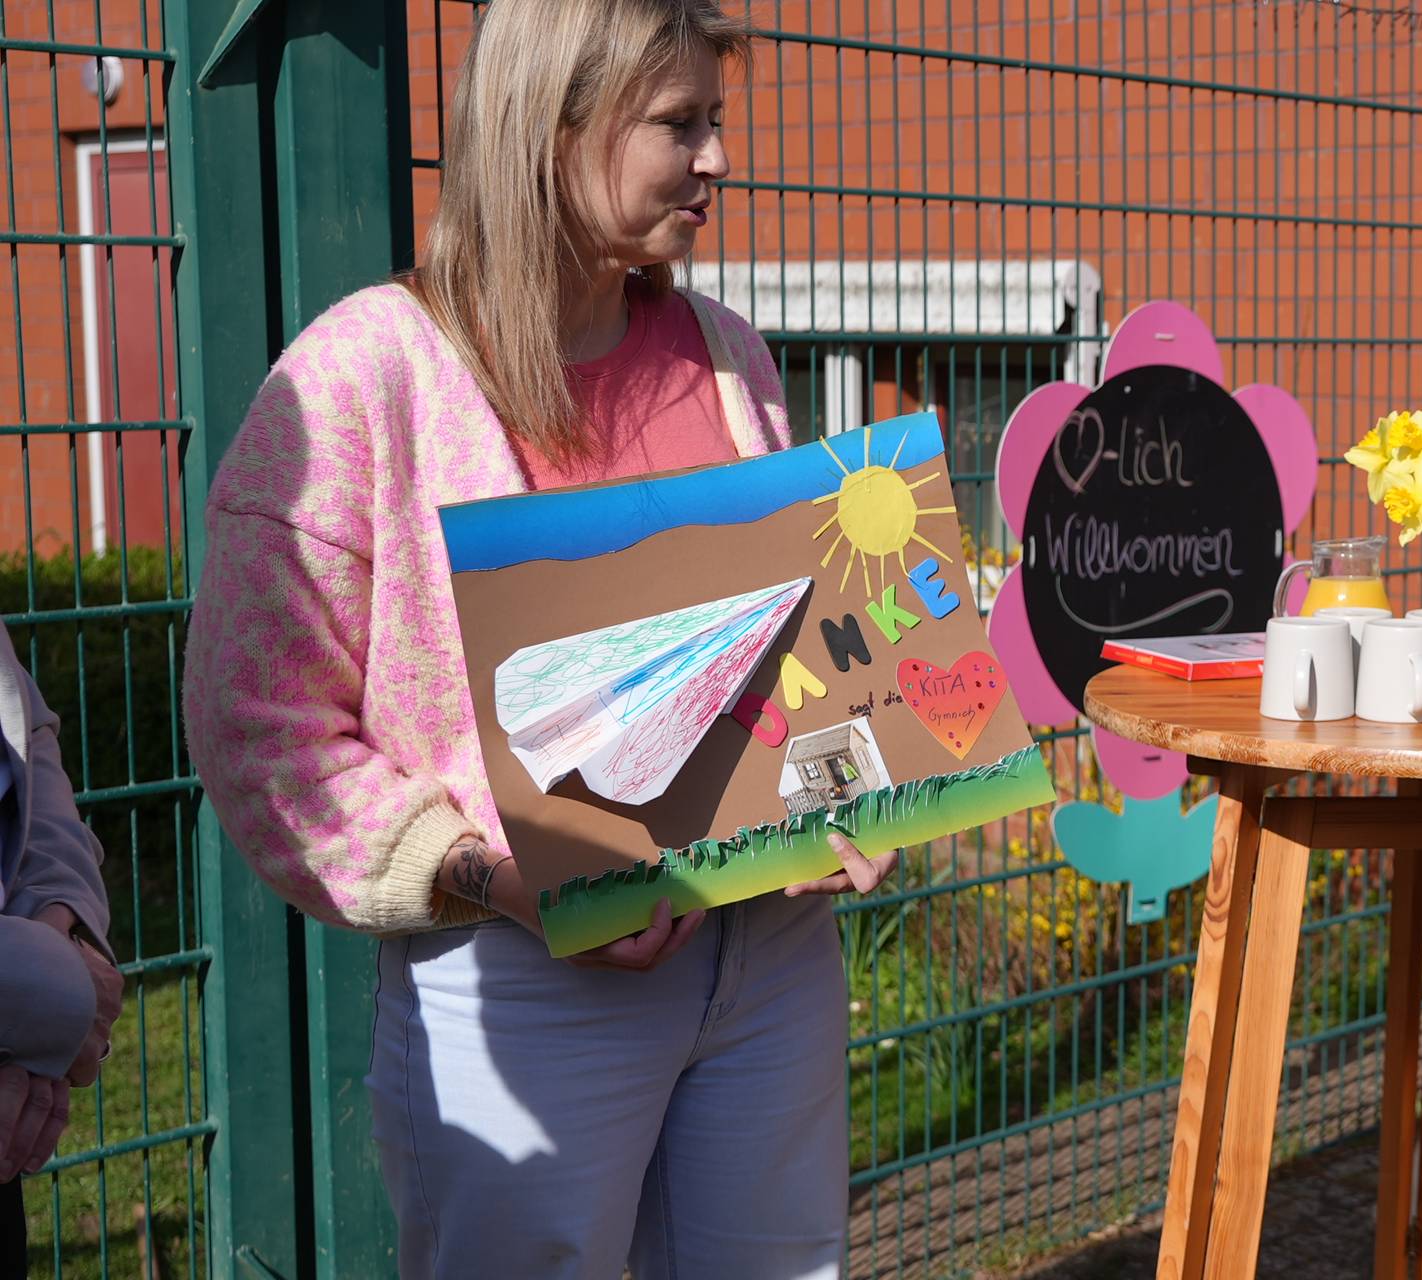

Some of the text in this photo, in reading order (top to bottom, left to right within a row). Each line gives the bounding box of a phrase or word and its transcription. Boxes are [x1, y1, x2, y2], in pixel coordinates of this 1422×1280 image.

[1045, 512, 1246, 581] Willkommen
[730, 557, 961, 749] DANKE
[919, 673, 966, 697] KITA
[848, 691, 875, 717] sagt
[928, 704, 976, 732] Gymnich
